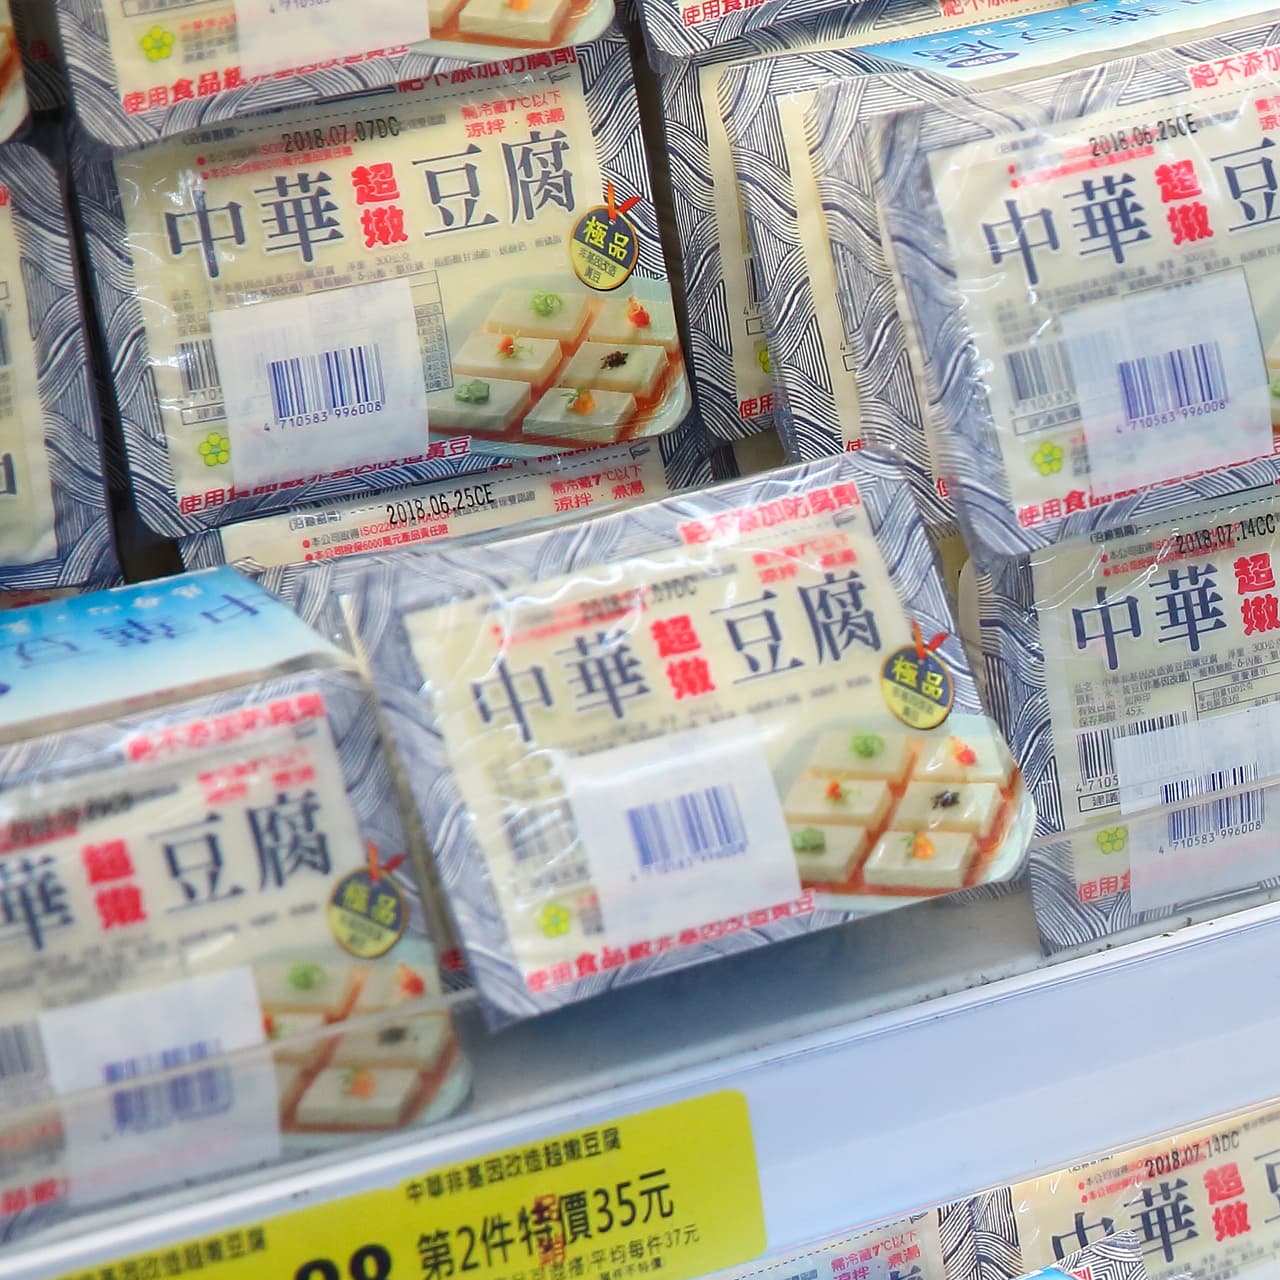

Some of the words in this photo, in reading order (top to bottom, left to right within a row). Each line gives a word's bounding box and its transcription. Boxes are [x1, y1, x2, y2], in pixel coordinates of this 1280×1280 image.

[281, 117, 400, 153] 2018.07.07DC
[1089, 112, 1197, 157] 2018.06.25CE
[165, 172, 342, 280] 中華
[351, 161, 409, 248] 超嫩
[411, 129, 577, 237] 豆腐
[980, 172, 1152, 286] 中華
[1154, 159, 1215, 247] 超嫩
[582, 215, 631, 261] 極品
[277, 409, 329, 432] 710583
[332, 400, 384, 420] 996008
[1179, 398, 1227, 420] 996008
[386, 483, 495, 526] 2018.06.25CE
[1175, 512, 1276, 556] 2018.07.14CC
[1070, 563, 1228, 671] 中華
[470, 628, 651, 743] 中華
[650, 615, 716, 701] 超嫩
[710, 570, 882, 685] 豆腐
[147, 789, 332, 915] 豆腐
[1171, 830, 1216, 851] 710583
[1219, 819, 1263, 841] 996008
[406, 1126, 621, 1202] 中華非基因改造超嫩豆腐
[1146, 1131, 1239, 1177] 2018.07.14DC
[1203, 1161, 1251, 1242] 超嫩
